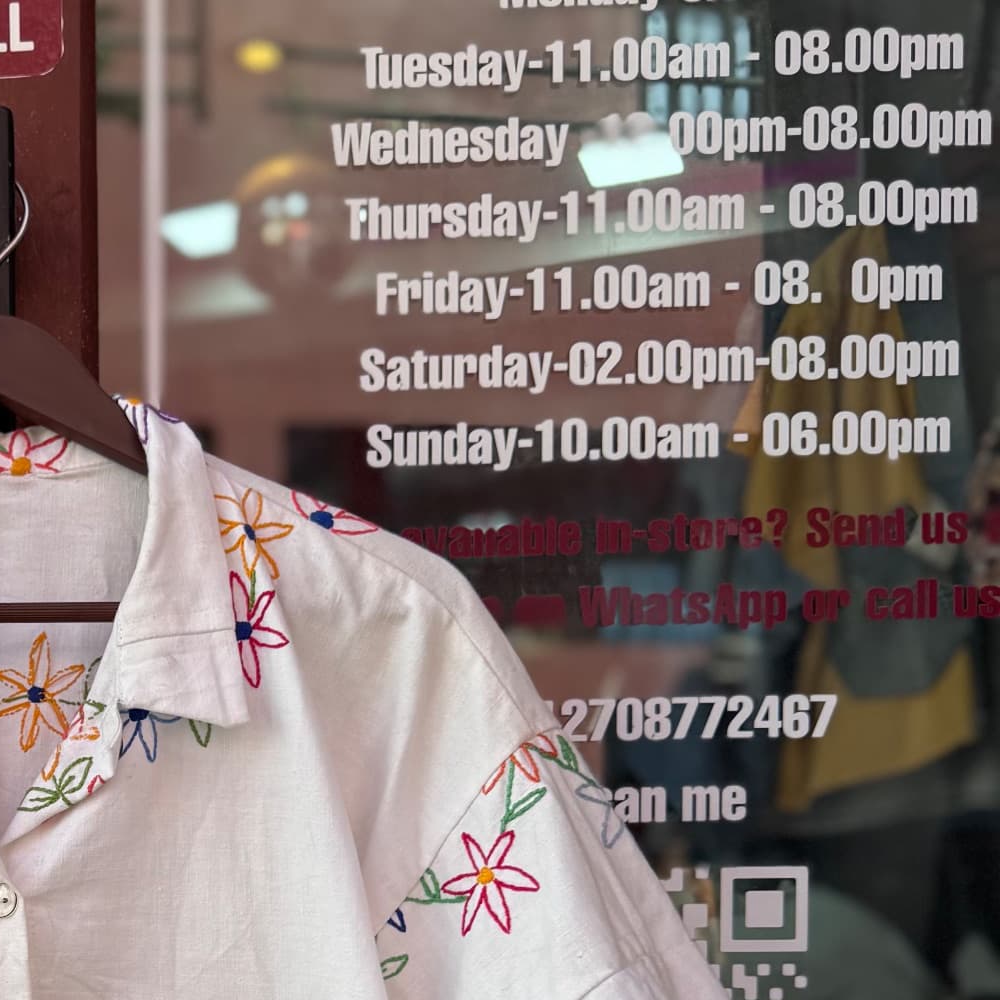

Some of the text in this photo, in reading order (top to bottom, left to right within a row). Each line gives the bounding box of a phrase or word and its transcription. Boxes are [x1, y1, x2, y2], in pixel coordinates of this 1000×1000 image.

[361, 37, 730, 92] Tuesday-11.00am
[774, 28, 964, 78] 08.00pm
[345, 188, 745, 242] Thursday-11.00am
[788, 181, 978, 232] 08.00pm
[376, 264, 710, 319] Friday-11.00am
[366, 416, 718, 471] Sunday-10.00am
[762, 410, 951, 461] 06.00pm
[806, 507, 907, 548] Send
[921, 511, 969, 545] us
[579, 582, 787, 631] WhatsApp
[802, 588, 850, 623] or
[865, 579, 938, 621] call
[546, 694, 837, 741] 2708772467
[603, 784, 747, 823] an me
